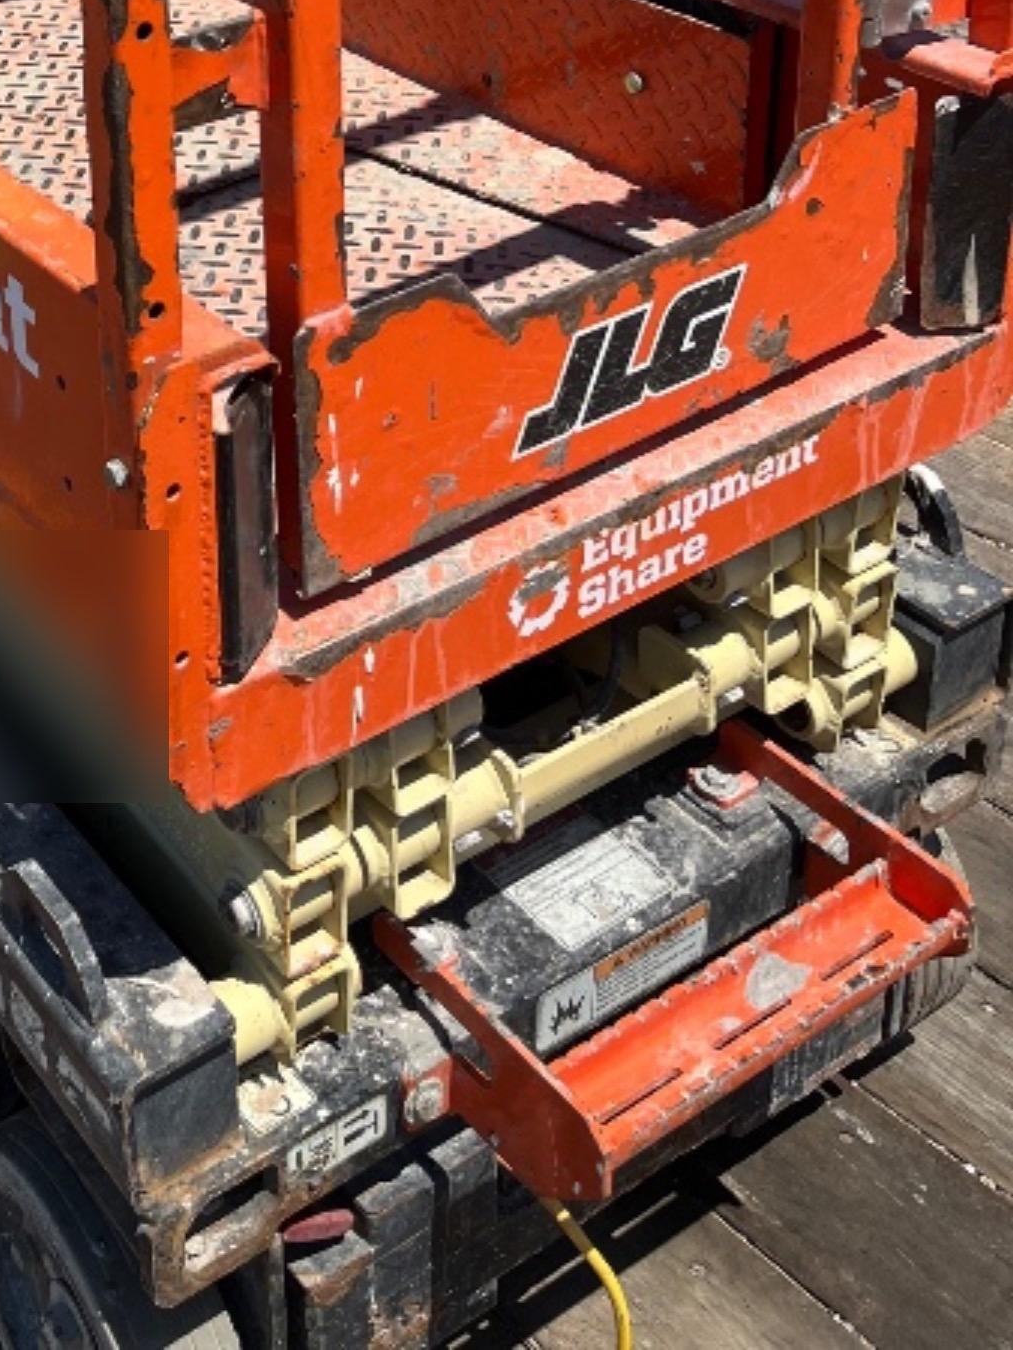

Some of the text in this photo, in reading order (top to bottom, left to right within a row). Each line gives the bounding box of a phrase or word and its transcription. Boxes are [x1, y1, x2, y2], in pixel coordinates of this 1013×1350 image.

[512, 263, 748, 461] JLG
[581, 434, 820, 572] Equipment
[577, 534, 708, 618] Share
